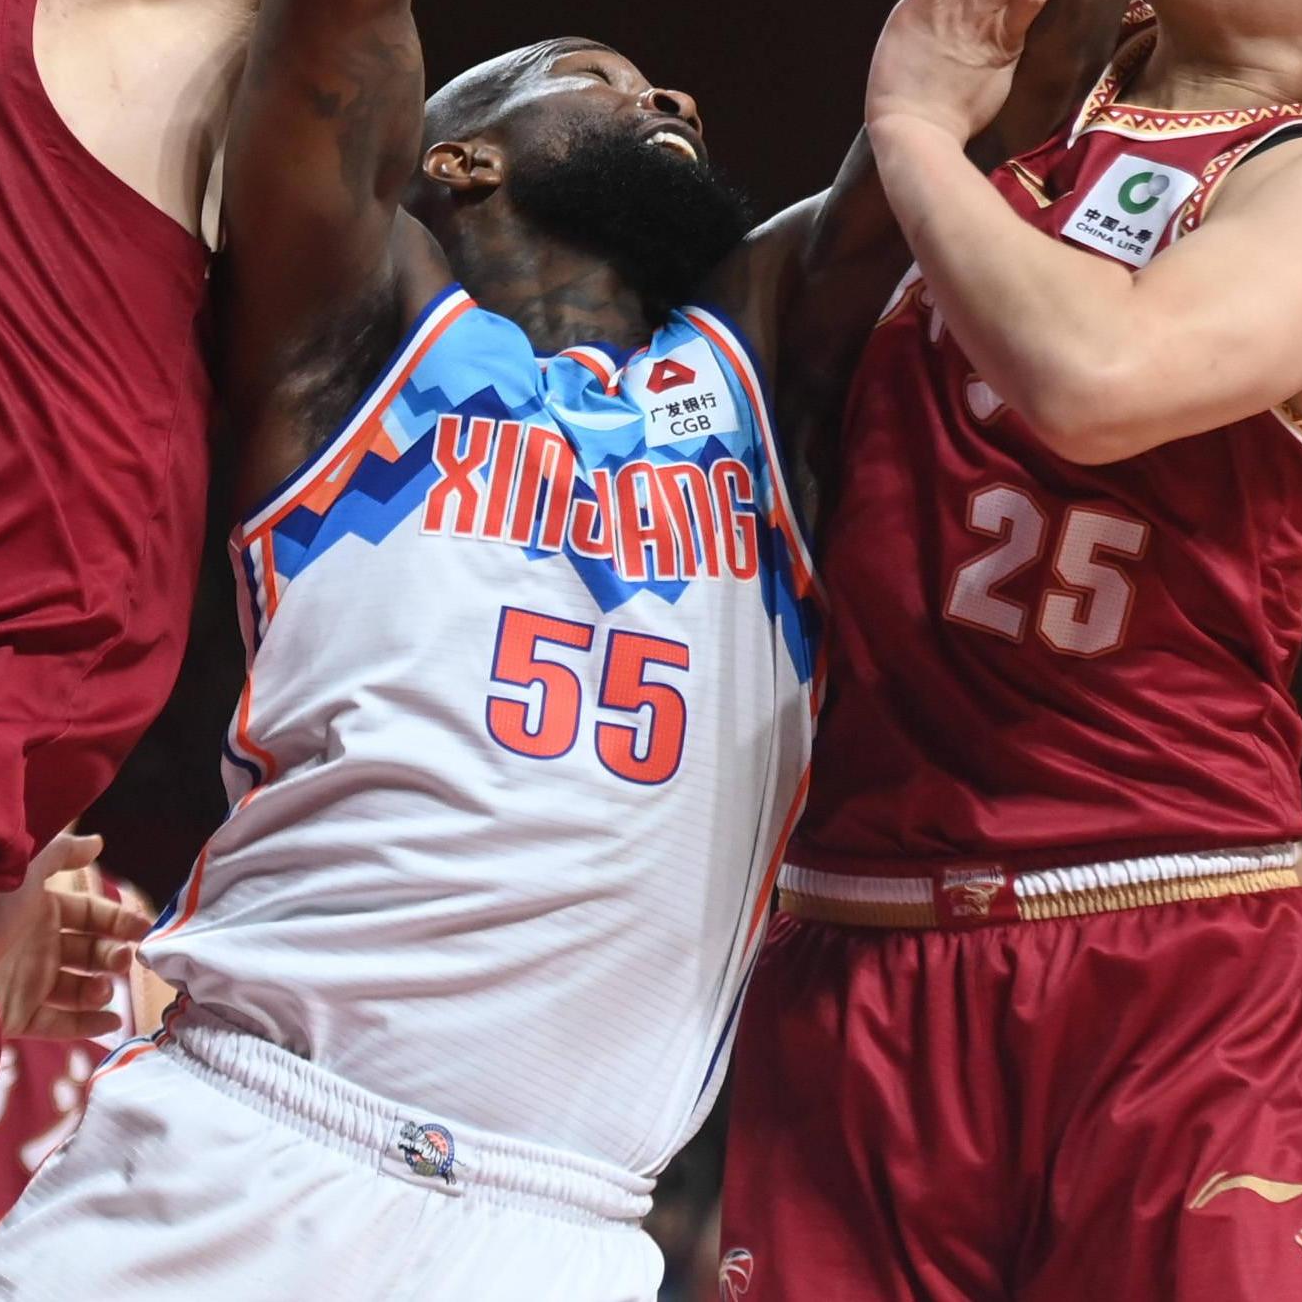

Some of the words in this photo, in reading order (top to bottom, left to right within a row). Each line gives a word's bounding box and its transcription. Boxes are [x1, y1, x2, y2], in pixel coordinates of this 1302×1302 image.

[1076, 222, 1114, 244] CHINA
[1116, 239, 1144, 255] LIFE
[1084, 209, 1153, 244] 中国人寿
[649, 392, 717, 423] 广发银行
[669, 414, 712, 436] CGB
[943, 482, 1151, 660] 25
[485, 604, 691, 787] 55
